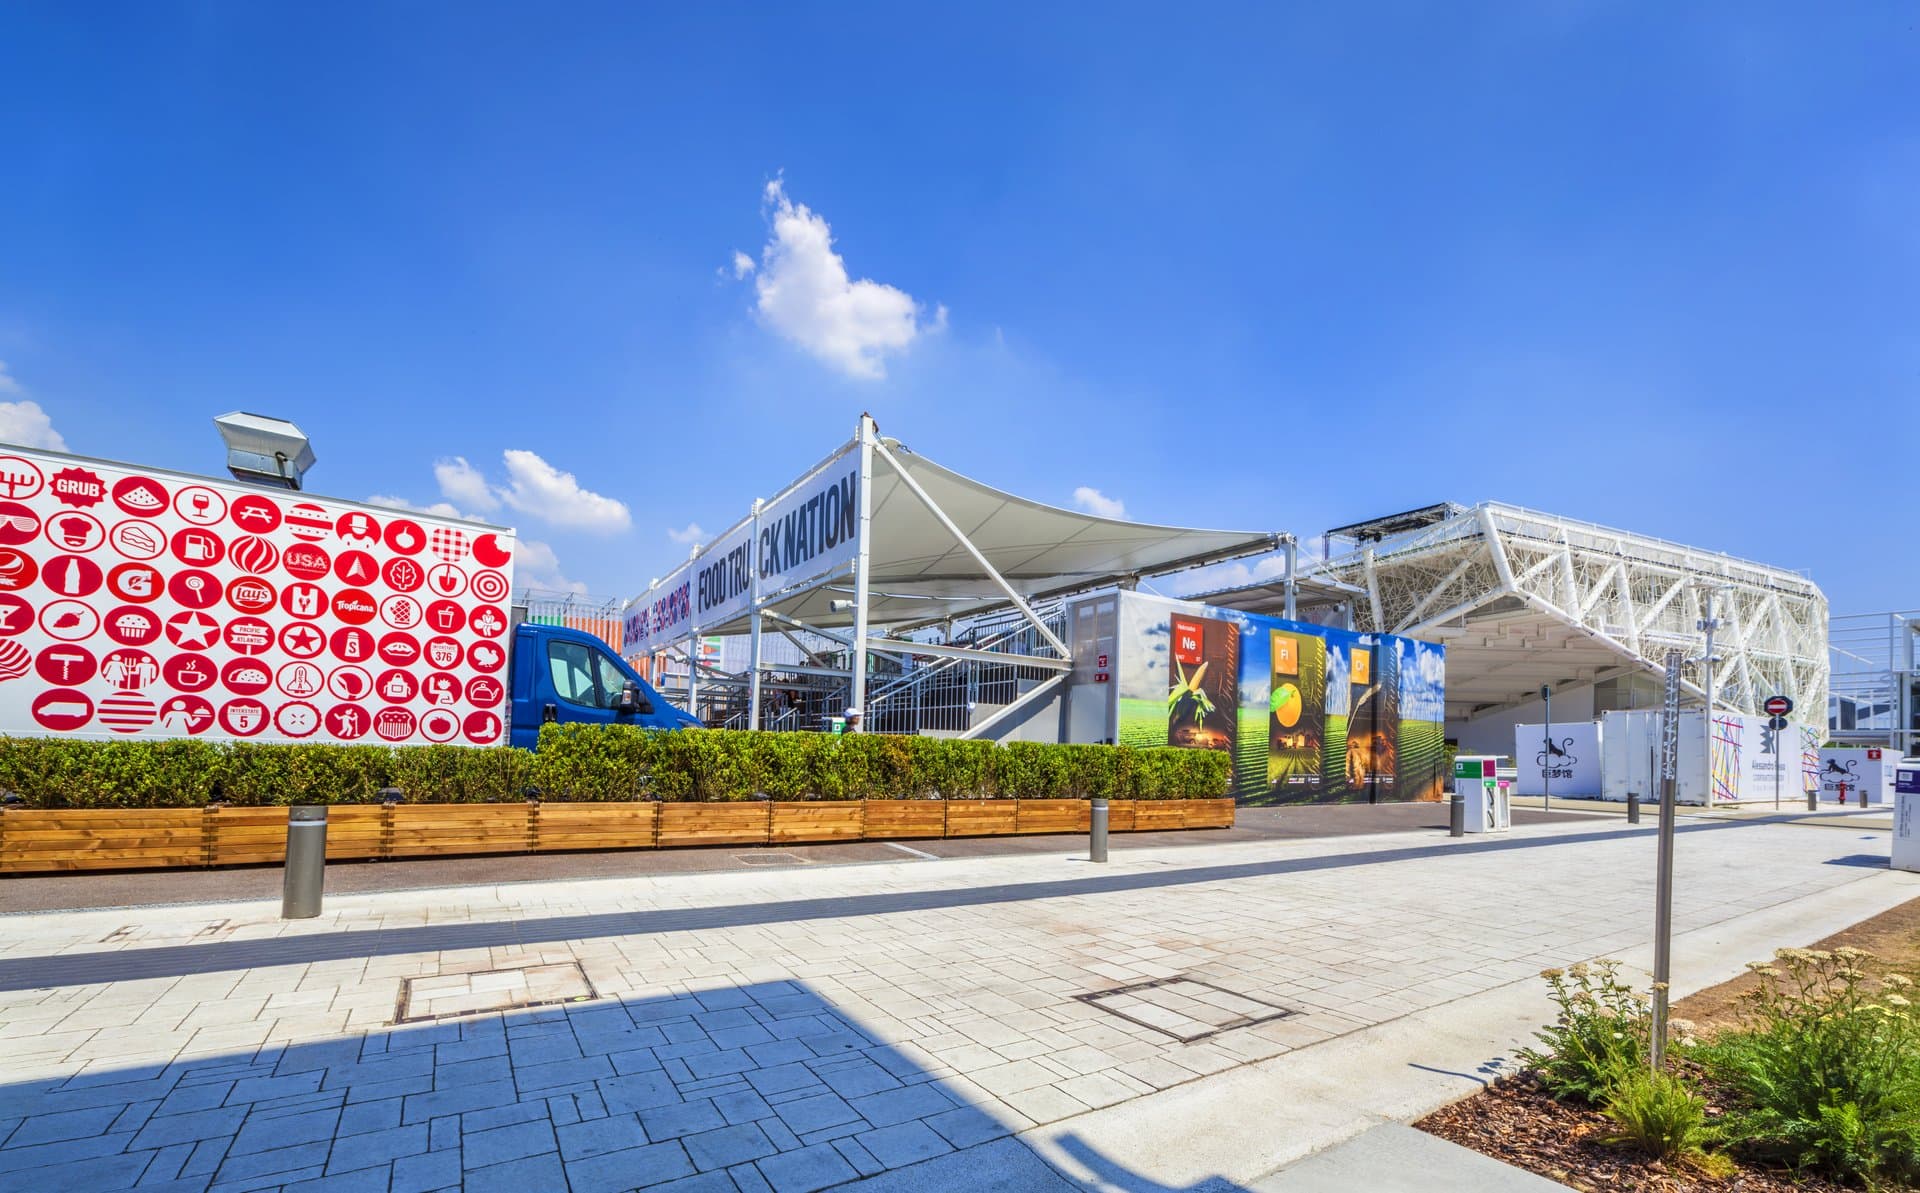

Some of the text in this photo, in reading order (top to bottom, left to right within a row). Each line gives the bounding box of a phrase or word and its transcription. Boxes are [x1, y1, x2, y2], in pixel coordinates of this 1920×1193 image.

[56, 478, 100, 498] GRUB
[698, 557, 727, 614] FOOD
[783, 470, 857, 572] NATION
[286, 551, 328, 570] USA
[336, 599, 376, 613] Tropicana
[239, 626, 262, 634] PACIFIC
[237, 636, 263, 644] ATLANTIC
[1182, 636, 1197, 651] Ne
[348, 641, 357, 654] S
[435, 651, 452, 662] 376
[1309, 637, 1325, 709] Farming
[240, 715, 249, 728] 5
